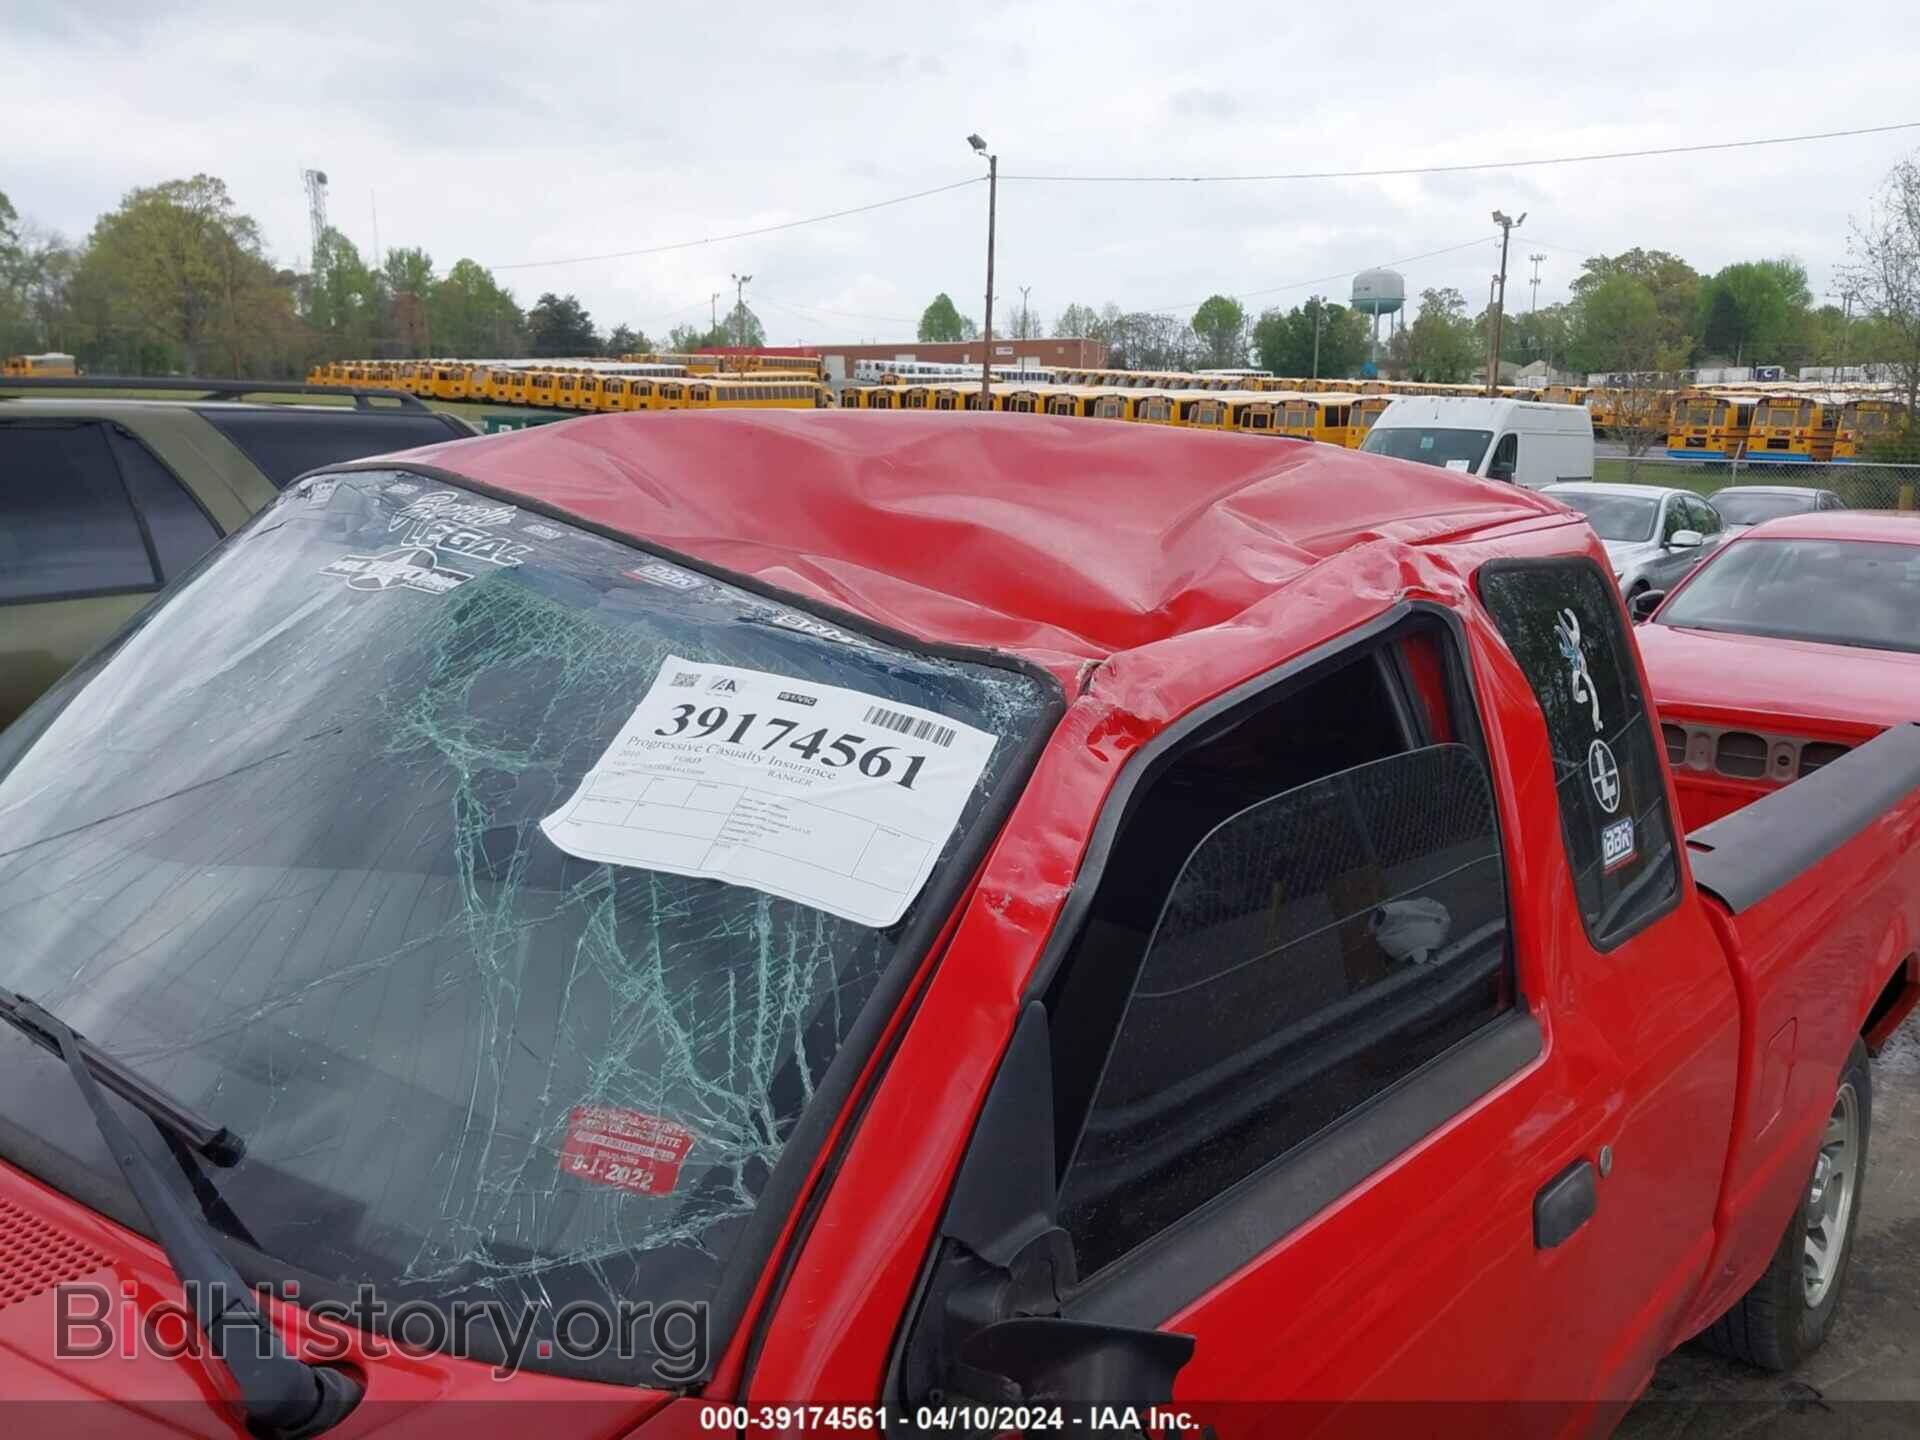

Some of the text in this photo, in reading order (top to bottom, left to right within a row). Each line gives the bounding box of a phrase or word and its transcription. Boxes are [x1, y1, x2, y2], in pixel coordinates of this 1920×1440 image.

[626, 735, 837, 780] Progressive Casualty Insurance
[654, 703, 928, 791] 39174561
[766, 769, 815, 786] RANGER
[1602, 820, 1633, 858] BBK
